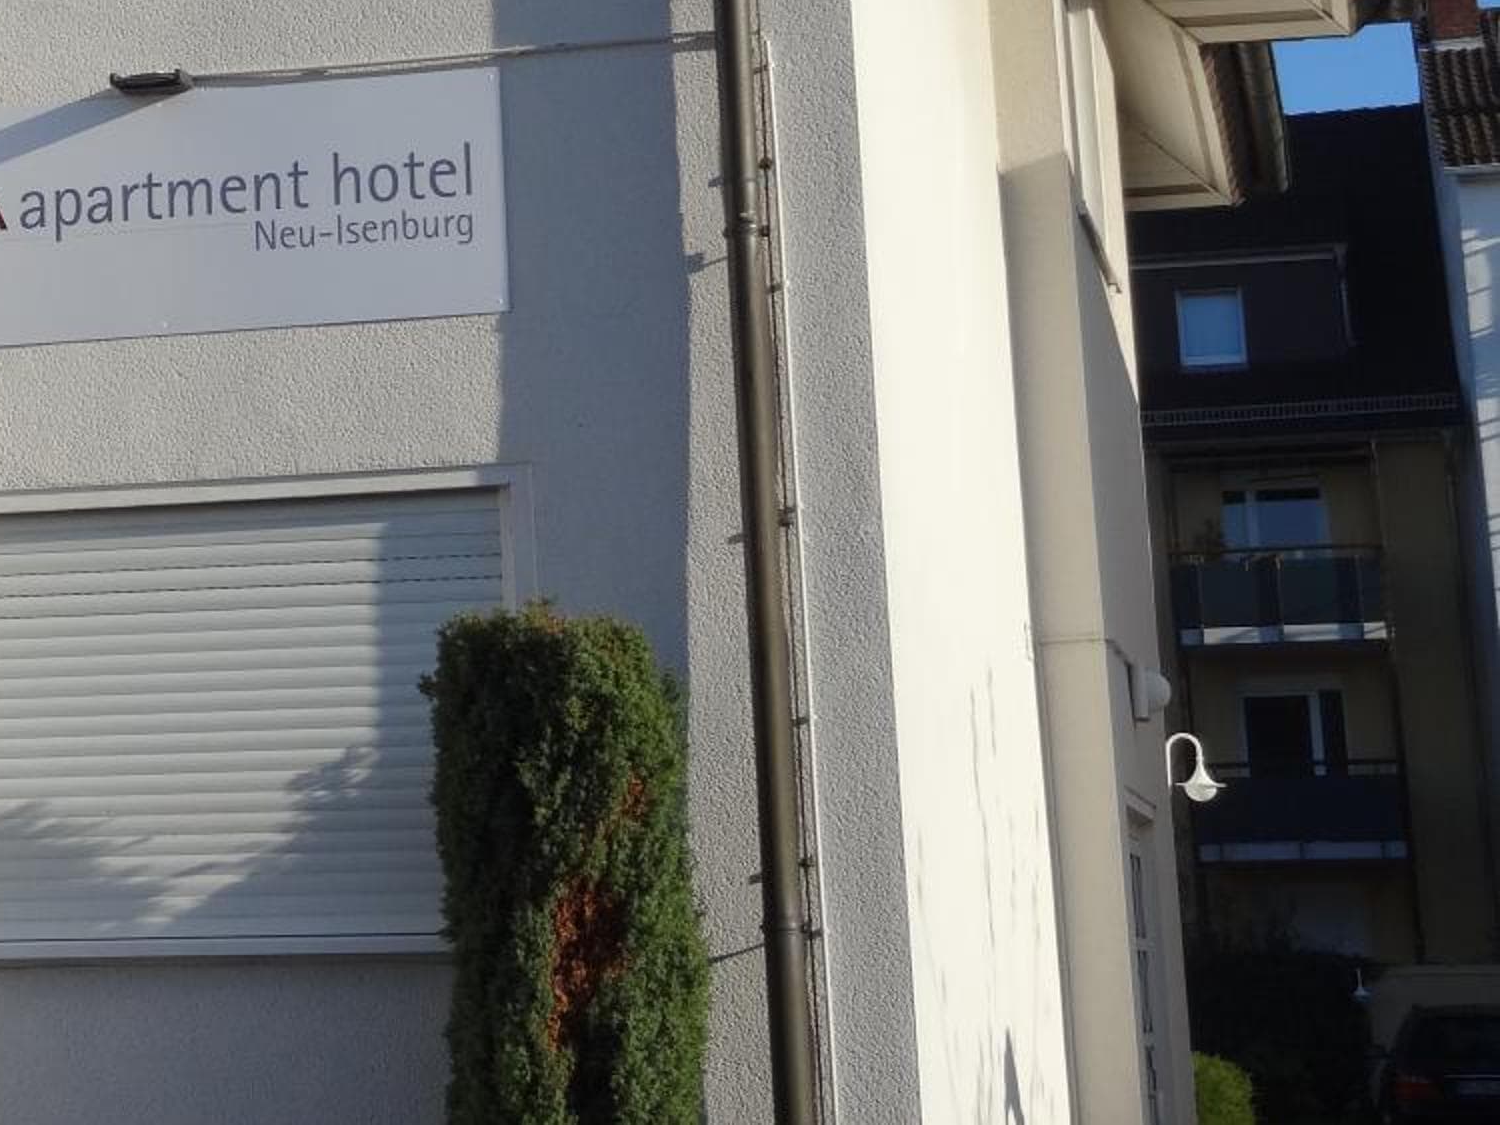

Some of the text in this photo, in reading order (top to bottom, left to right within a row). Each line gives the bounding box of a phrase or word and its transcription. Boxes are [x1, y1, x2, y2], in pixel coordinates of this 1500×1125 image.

[19, 161, 309, 242] apartment
[332, 142, 473, 206] hotel
[254, 210, 475, 252] Neu-Isenburg
